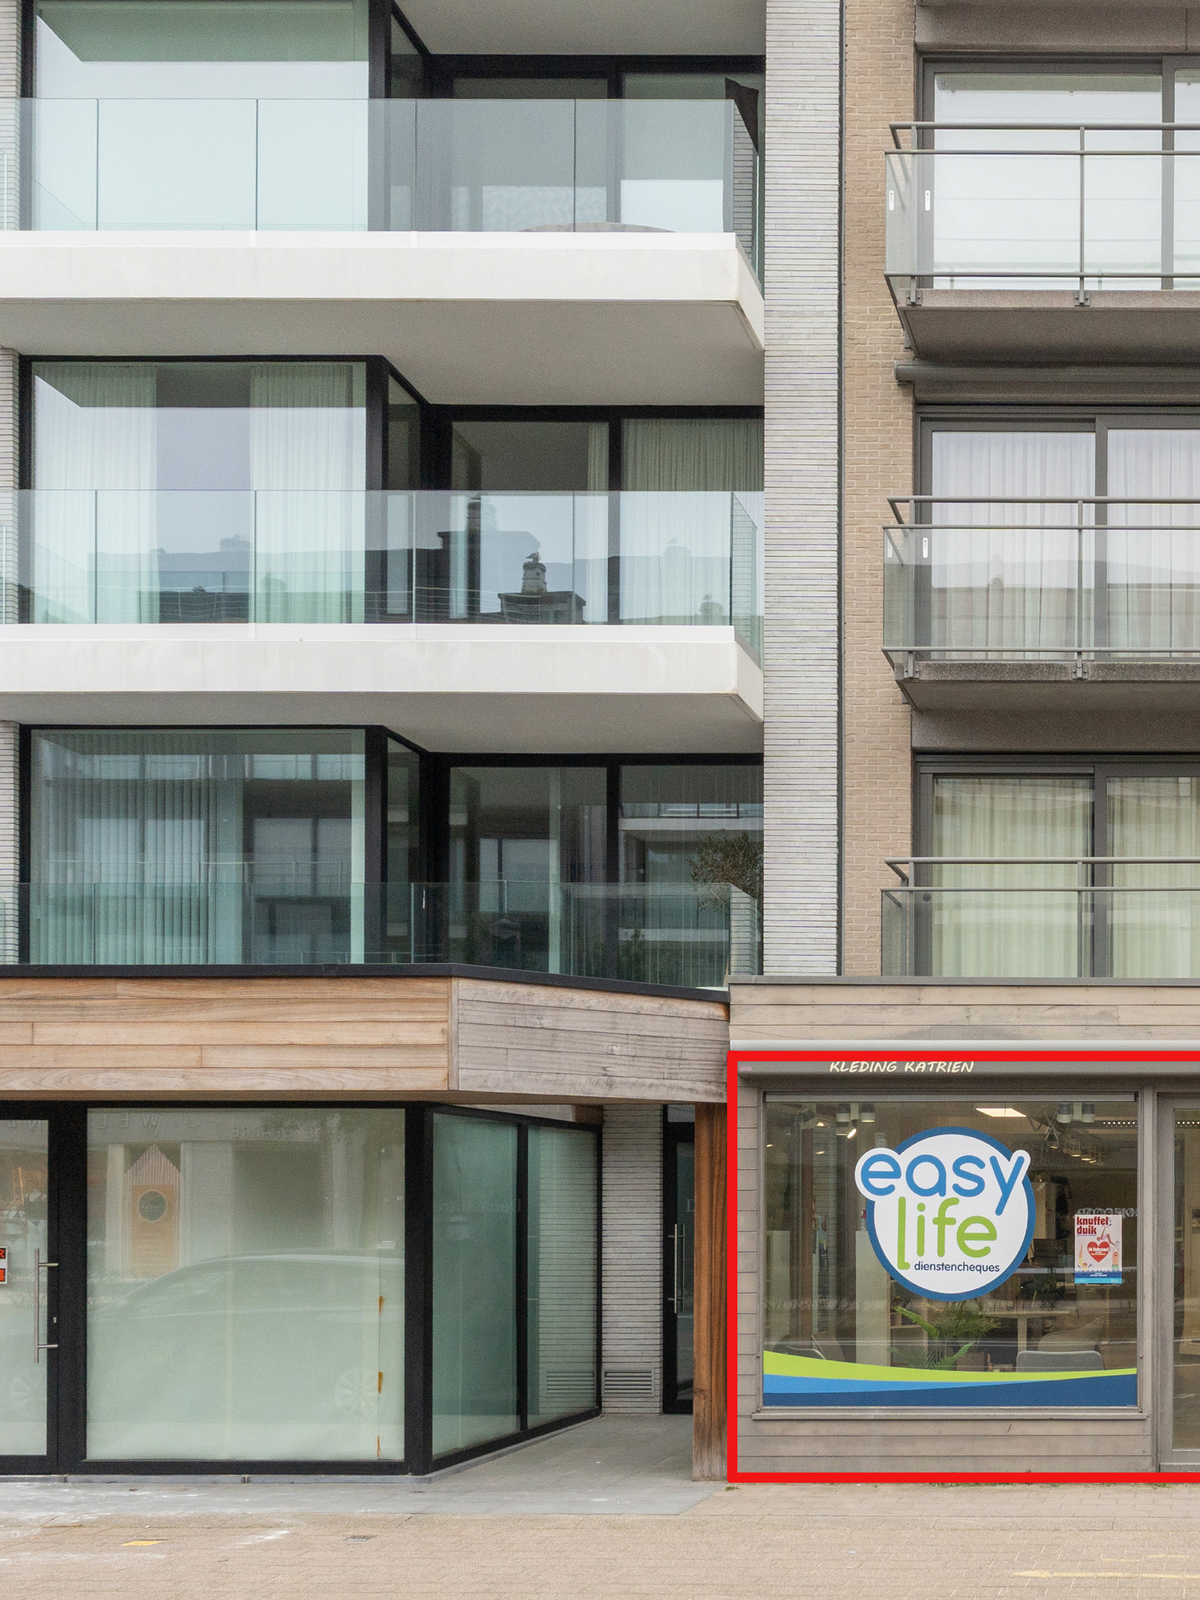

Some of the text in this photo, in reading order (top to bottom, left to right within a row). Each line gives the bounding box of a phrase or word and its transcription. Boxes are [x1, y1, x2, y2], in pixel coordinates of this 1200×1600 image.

[829, 1060, 975, 1073] KLEDING KATRIEN
[860, 1153, 1025, 1216] easy
[1076, 1216, 1109, 1226] knuffel
[897, 1195, 998, 1271] life
[1076, 1225, 1097, 1234] duik
[914, 1261, 1001, 1274] dienstencheques
